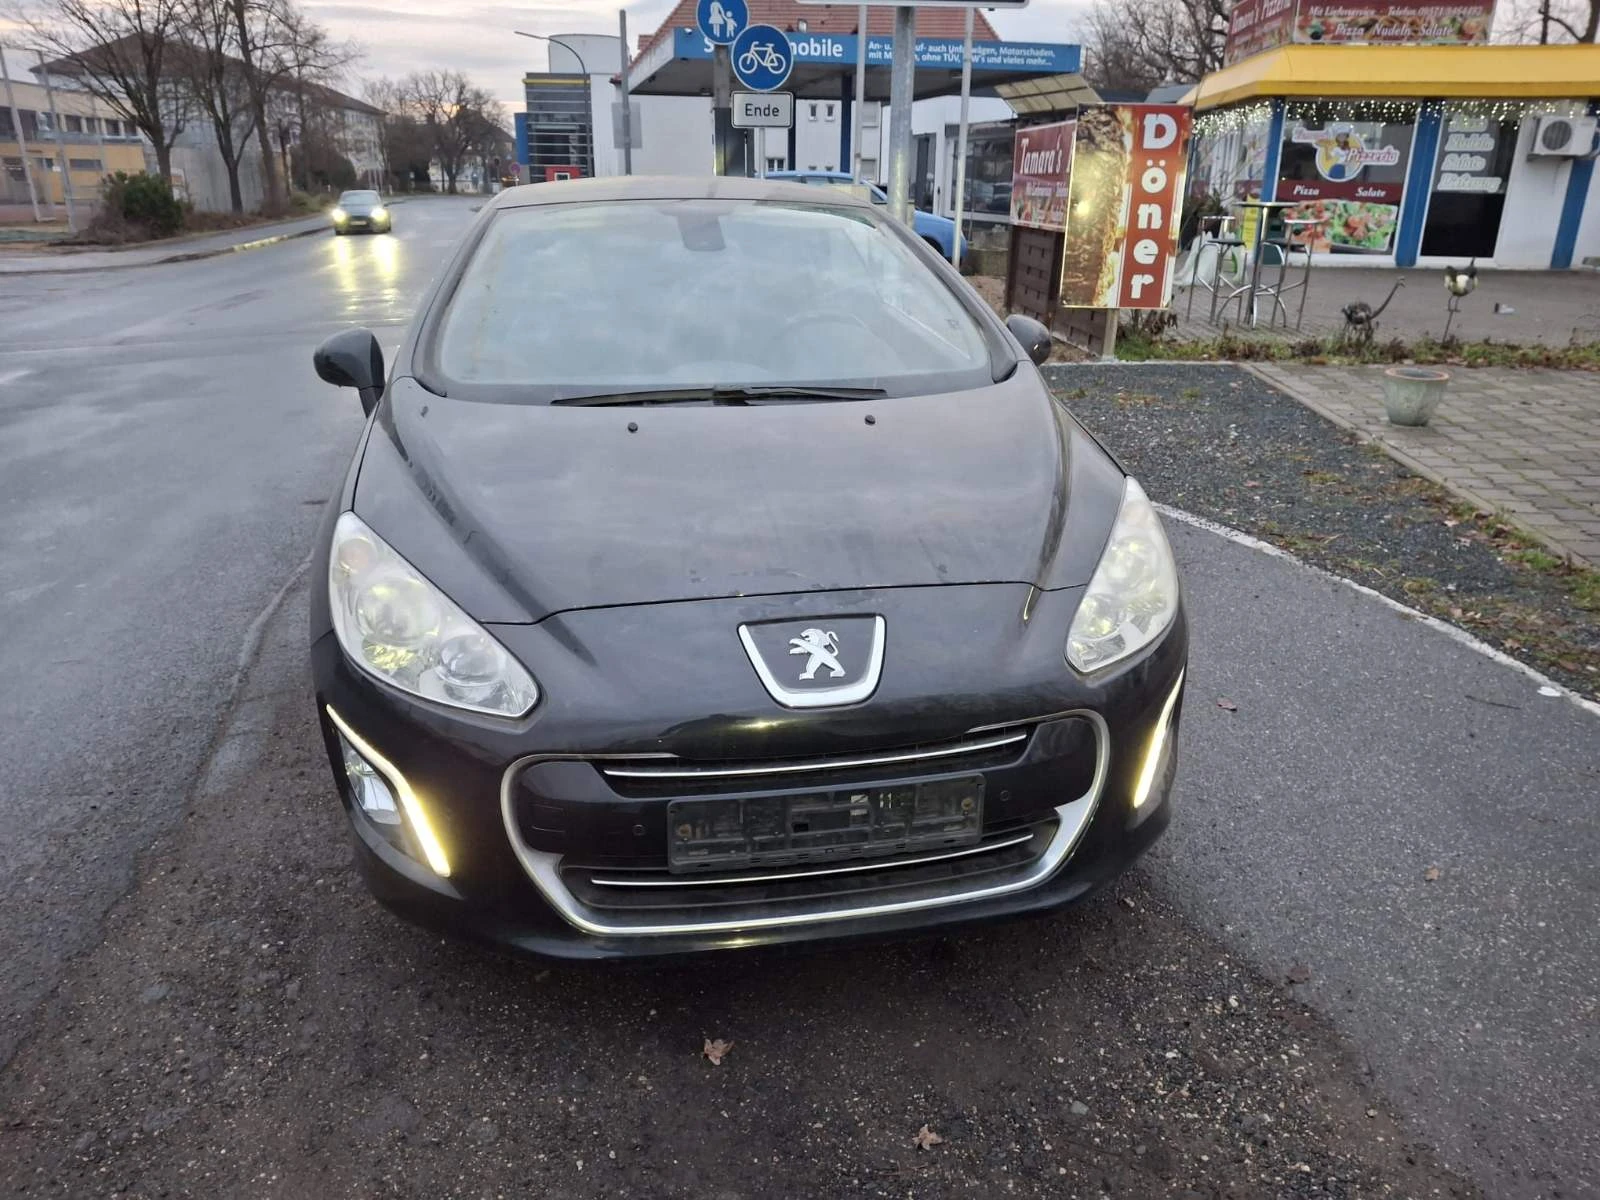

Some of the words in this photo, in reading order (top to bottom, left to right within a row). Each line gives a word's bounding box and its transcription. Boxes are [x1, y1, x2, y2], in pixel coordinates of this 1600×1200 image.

[1335, 23, 1365, 36] Pizza
[1371, 23, 1411, 36] Nudeln
[1420, 24, 1453, 36] Salate
[927, 44, 946, 52] auch
[921, 53, 941, 61] ohne
[986, 56, 1002, 65] und
[744, 103, 780, 117] Ende
[1020, 134, 1062, 174] Tamara's
[1347, 147, 1397, 163] Pizzeria
[1293, 185, 1320, 196] Pizza
[1355, 186, 1386, 197] Salate
[1131, 113, 1177, 299] Döner
